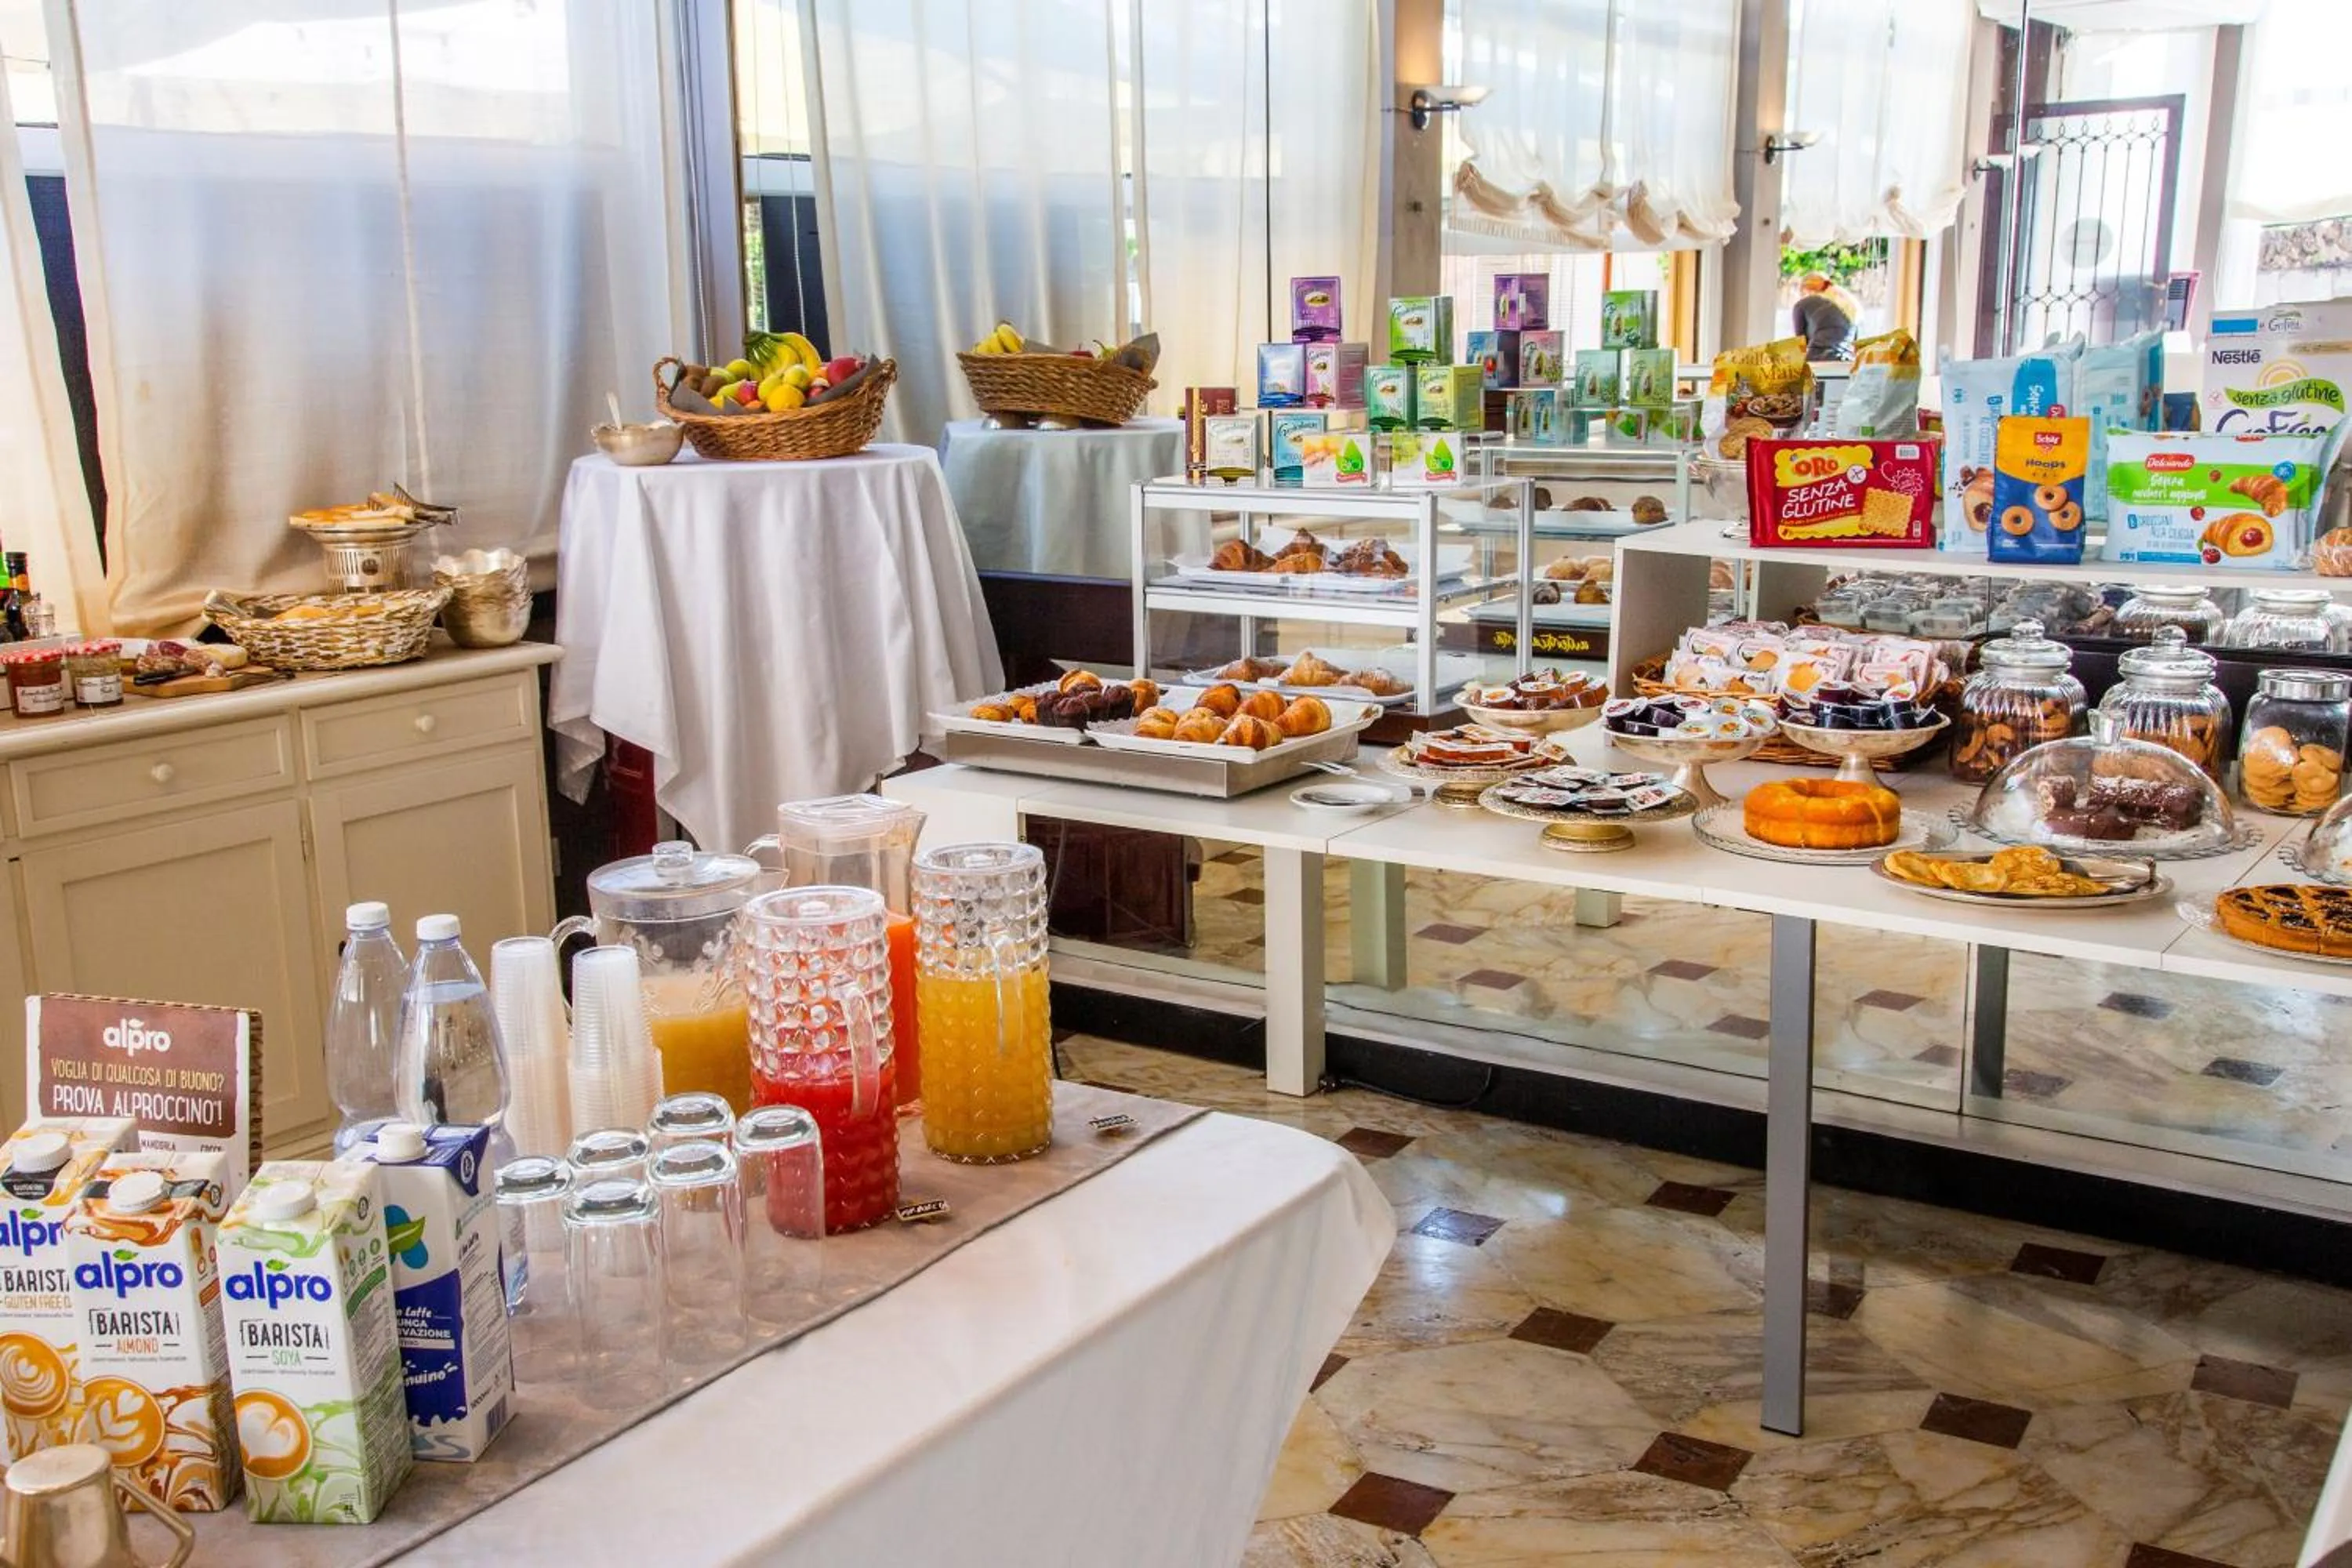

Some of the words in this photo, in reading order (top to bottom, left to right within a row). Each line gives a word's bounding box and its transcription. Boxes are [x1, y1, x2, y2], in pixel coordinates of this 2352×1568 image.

[2232, 392, 2278, 406] senza
[2281, 382, 2340, 403] glutine
[2025, 459, 2066, 470] Hoops
[1787, 478, 1848, 503] SENZA
[1782, 493, 1857, 519] GLUTINE
[103, 1018, 172, 1057] alpro
[50, 1058, 89, 1080] VOGLIA
[92, 1062, 103, 1081] DI
[106, 1063, 162, 1087] QUALCOSA
[165, 1069, 177, 1088] DI
[180, 1070, 226, 1093] BUONO?
[53, 1084, 105, 1115] PROVA
[0, 1210, 64, 1257] lpr
[74, 1250, 183, 1299] alpro
[225, 1261, 332, 1309] alpro
[96, 1311, 174, 1336] BARISTA
[248, 1323, 323, 1348] BARISTA
[399, 1328, 452, 1338] VAZIONE
[117, 1338, 159, 1355] ALMOND
[271, 1349, 302, 1367] SOYA
[405, 1369, 446, 1387] nuino
